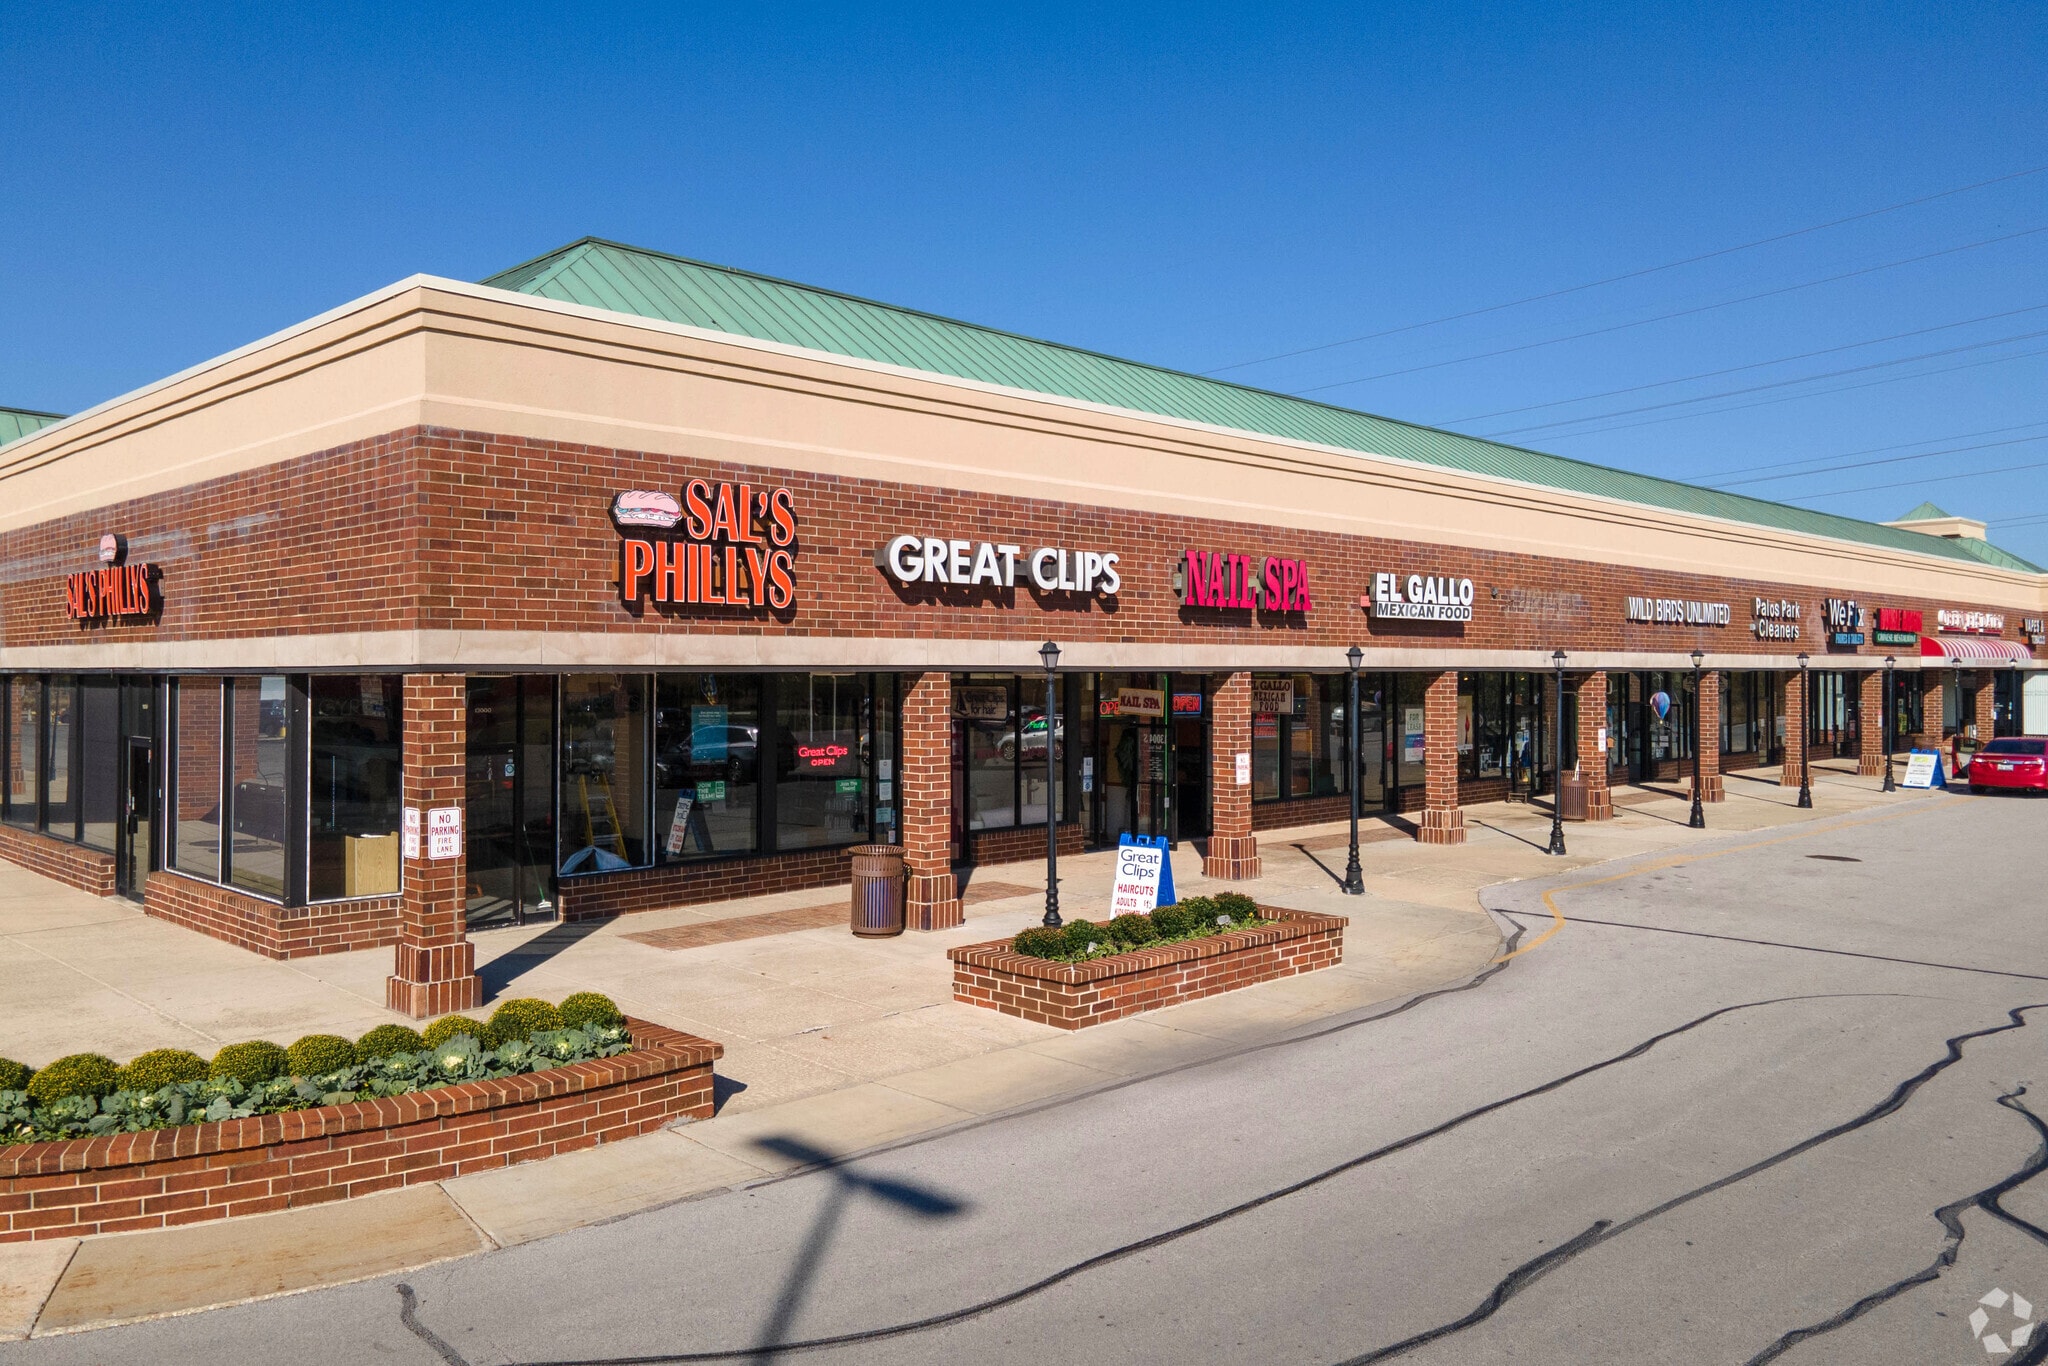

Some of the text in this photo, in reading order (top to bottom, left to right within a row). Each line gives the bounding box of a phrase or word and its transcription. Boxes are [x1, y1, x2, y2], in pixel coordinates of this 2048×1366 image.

[686, 478, 795, 547] SAL'S
[888, 535, 1121, 595] GREAT CLIPS
[624, 538, 793, 609] PHILLYS
[1185, 549, 1313, 612] NAIL SPA
[66, 563, 149, 619] SAL'S PHILLYS
[1376, 572, 1402, 602] EL
[1407, 574, 1474, 606] GALLO
[1377, 603, 1471, 619] MEXICAN FOOD
[1628, 596, 1730, 624] WILD BIRDS UNLIMITED
[1755, 597, 1800, 618] Palos Park
[1758, 618, 1800, 639] Cleaners
[1260, 681, 1290, 691] GALLO
[1120, 695, 1161, 710] NAIL SPA
[1172, 695, 1200, 712] OPEN
[1254, 692, 1286, 702] MEXICAN
[1100, 701, 1120, 715] OPE
[1260, 701, 1280, 711] FOOD
[798, 745, 848, 758] Great Clips
[810, 758, 836, 767] OPEN
[439, 814, 451, 824] NO
[431, 825, 459, 836] PARKING
[437, 837, 452, 845] FIRE
[436, 845, 453, 853] LANE
[1121, 849, 1159, 864] Great
[1122, 863, 1155, 880] Clips
[1117, 883, 1154, 896] HAIRCUTS
[1116, 897, 1137, 908] ADULTS
